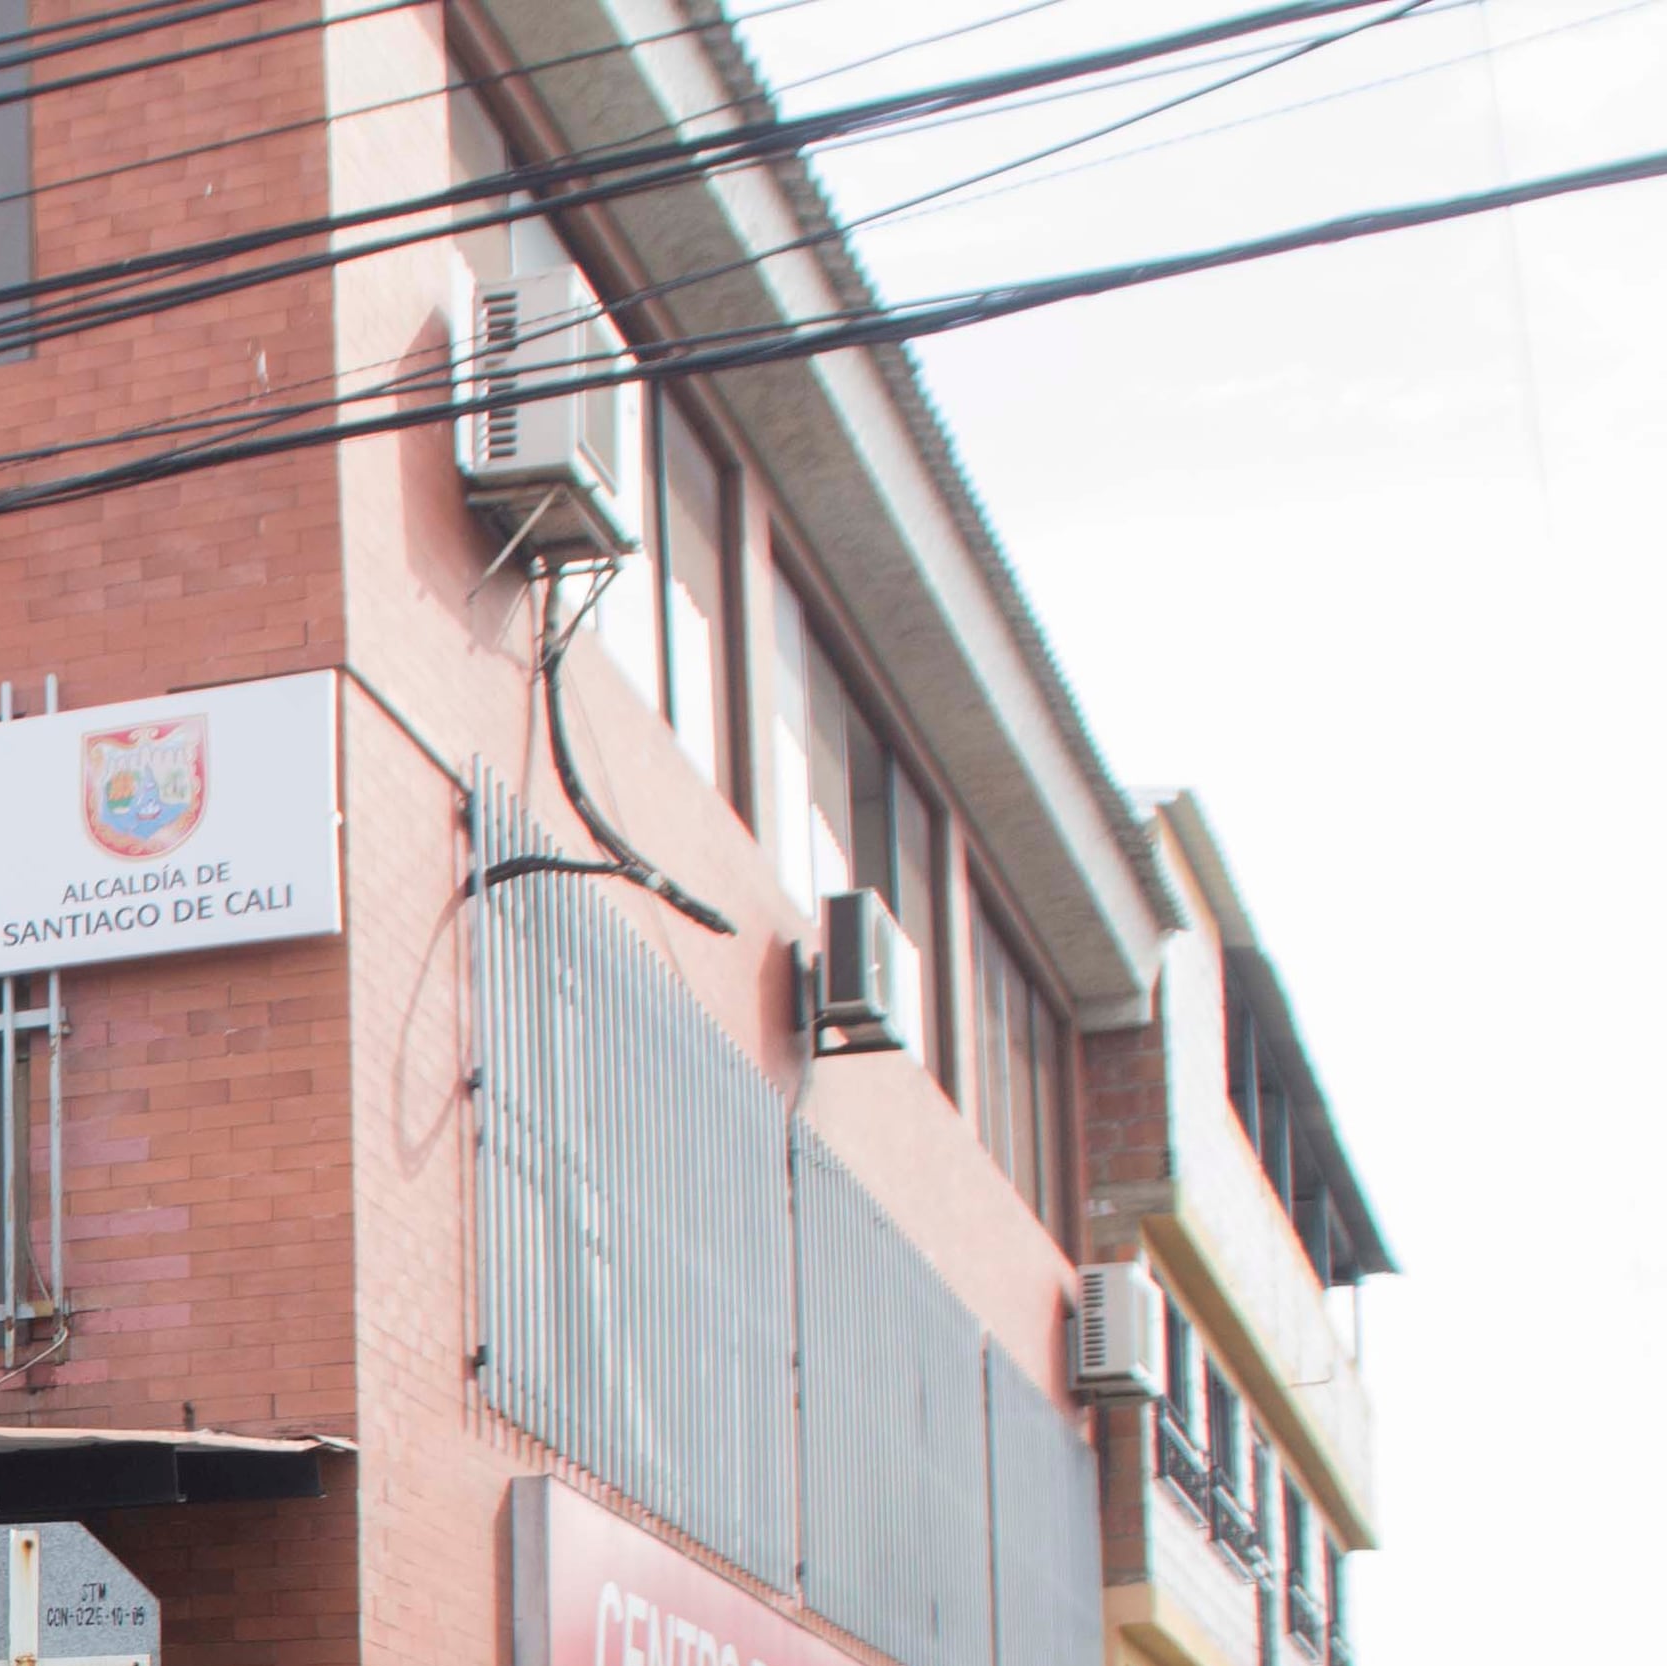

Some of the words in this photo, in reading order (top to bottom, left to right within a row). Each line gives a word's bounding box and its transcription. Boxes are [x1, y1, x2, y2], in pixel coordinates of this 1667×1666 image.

[61, 863, 186, 904] ALCALDÍA
[196, 861, 231, 885] DE
[3, 903, 161, 946] SANTIAGO
[173, 895, 214, 923] DE
[225, 883, 294, 915] CALI
